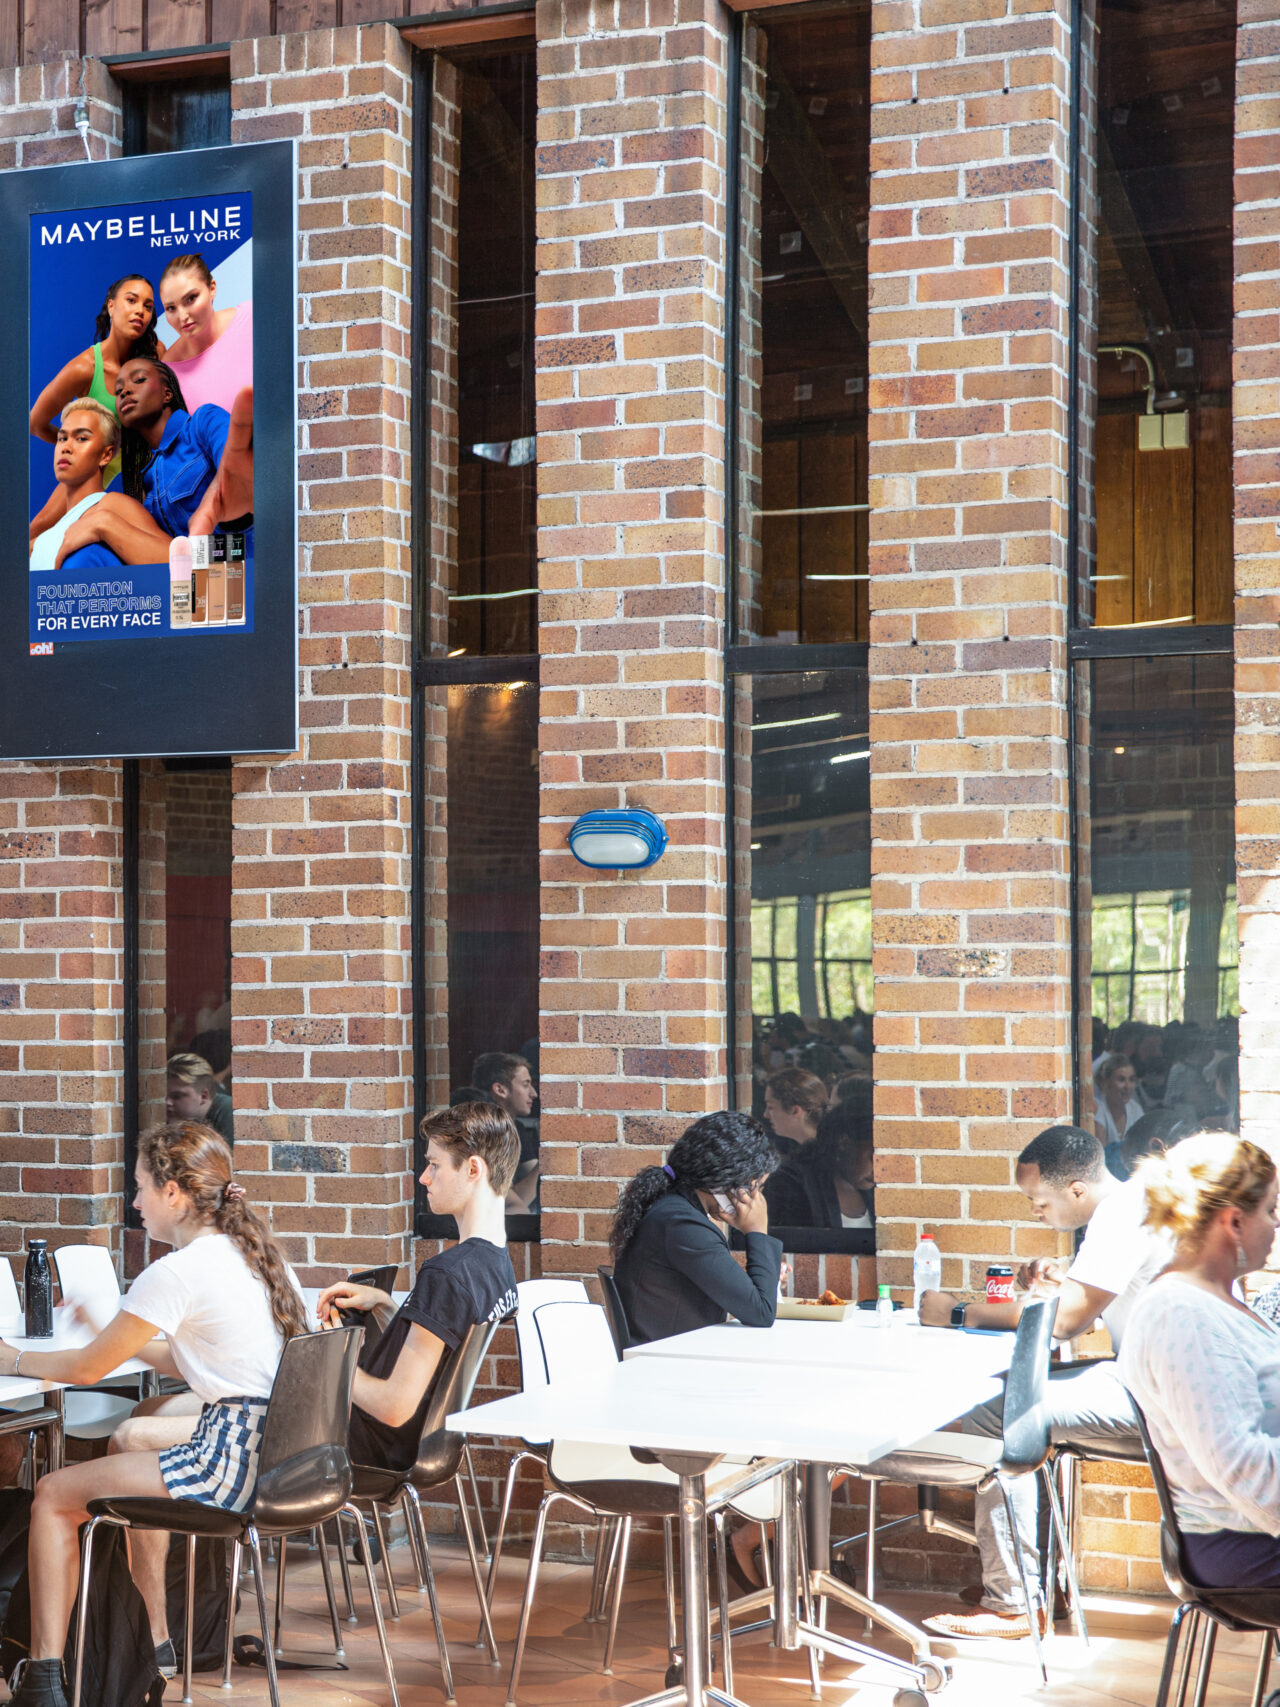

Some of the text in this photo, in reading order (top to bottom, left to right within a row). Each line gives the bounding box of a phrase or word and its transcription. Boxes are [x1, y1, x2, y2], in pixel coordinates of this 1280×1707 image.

[41, 206, 241, 246] MAYBELLINE
[150, 228, 241, 248] NEW YORK
[37, 581, 133, 600] FOUNDATION
[37, 600, 75, 615] THAT
[78, 595, 162, 613] PERFORMS
[37, 612, 162, 631] FOR EVERY FACE
